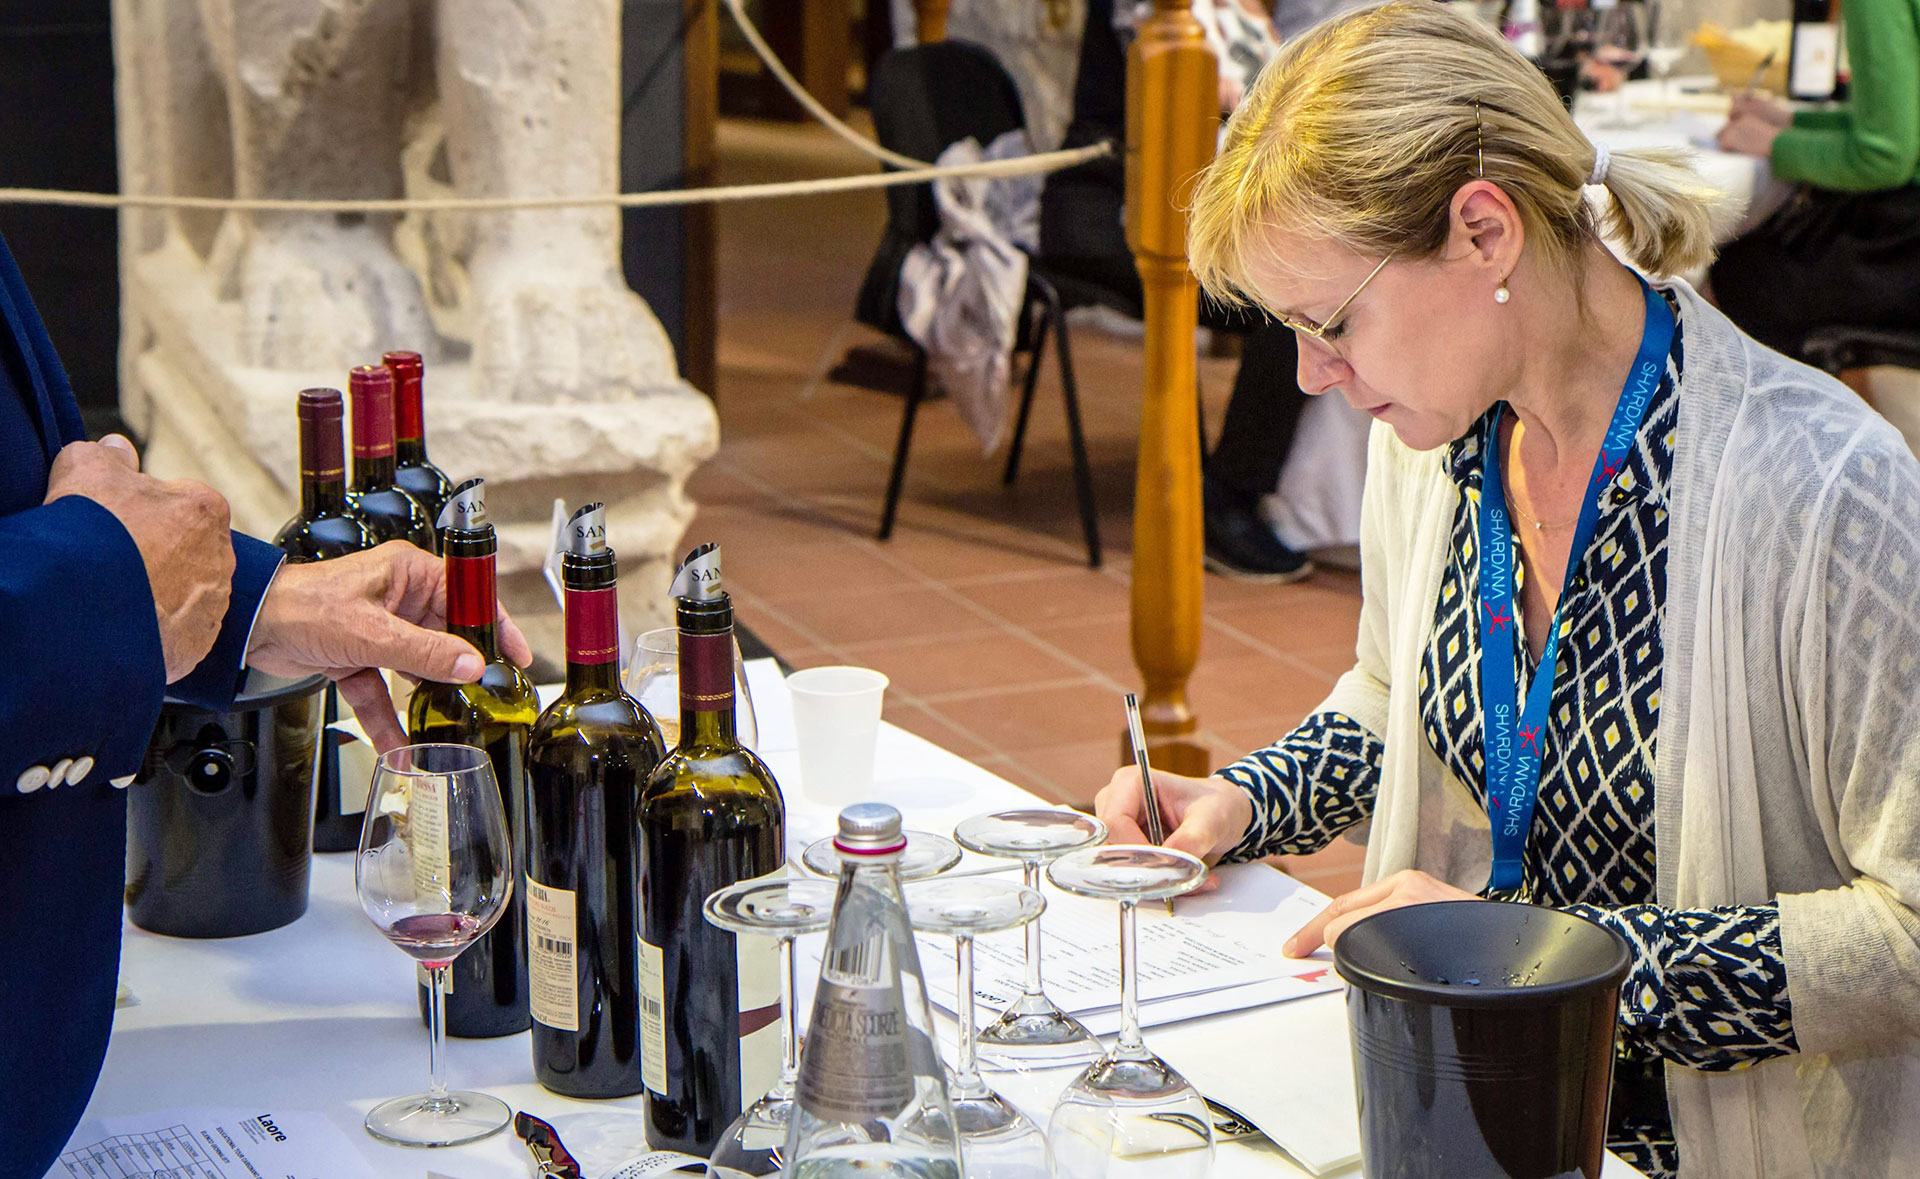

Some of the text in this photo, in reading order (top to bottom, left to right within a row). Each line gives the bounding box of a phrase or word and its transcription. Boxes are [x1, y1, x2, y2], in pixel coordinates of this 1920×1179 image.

[1611, 361, 1657, 450] SHARDANA
[1490, 508, 1506, 600] SHARDANA
[1504, 756, 1532, 837] SHARDANA
[257, 1113, 288, 1142] Laore
